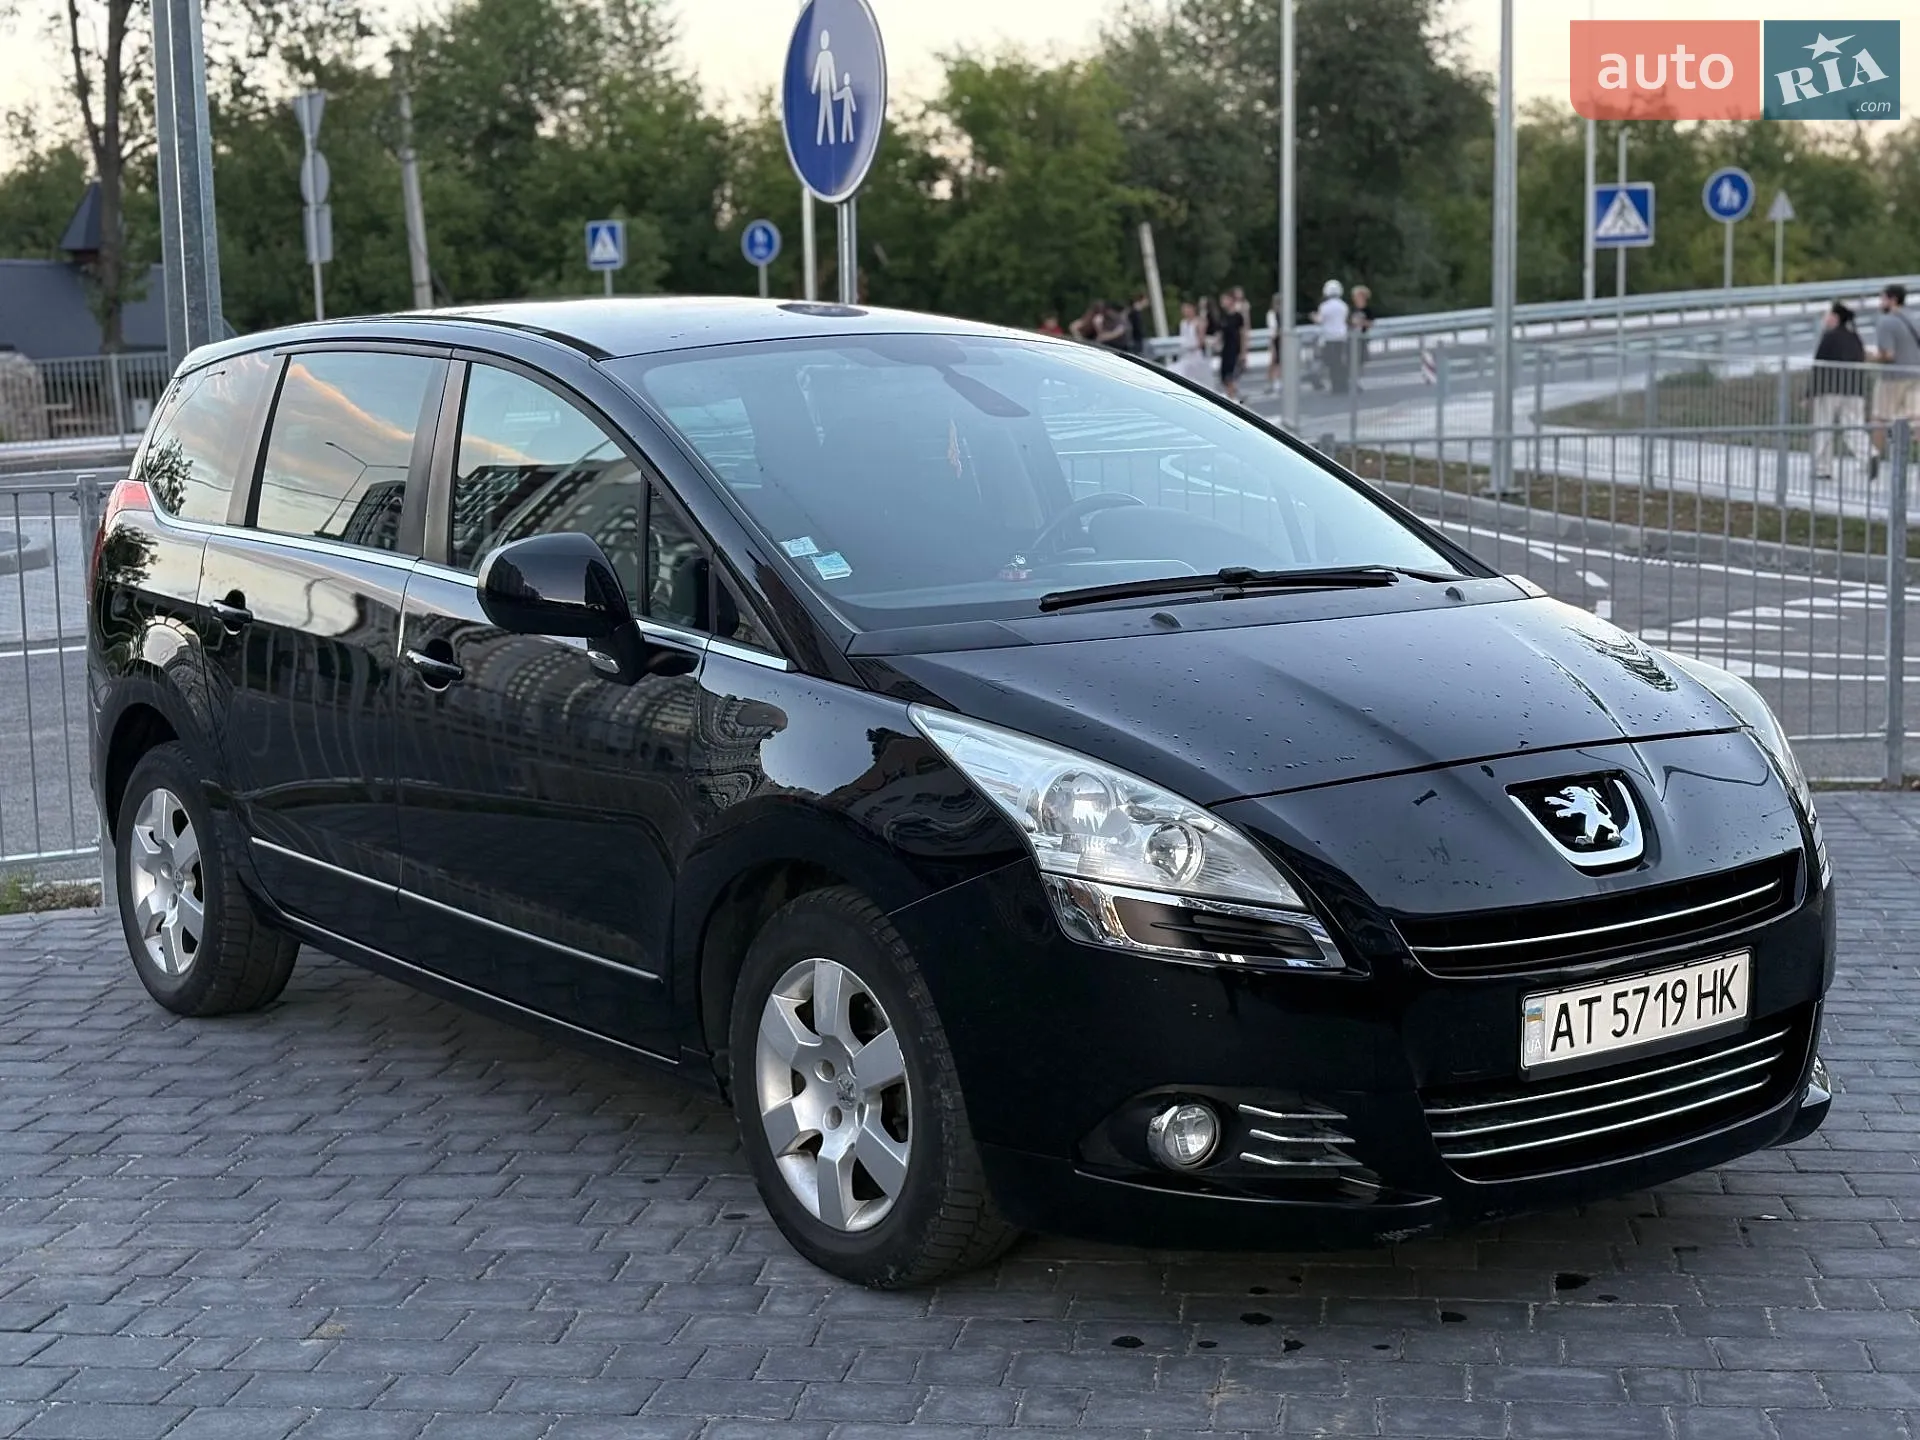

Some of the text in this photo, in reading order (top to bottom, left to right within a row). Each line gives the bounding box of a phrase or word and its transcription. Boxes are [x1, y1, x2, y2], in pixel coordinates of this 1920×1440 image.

[1550, 963, 1739, 1052] AT 5719 HK
[1526, 1038, 1542, 1055] UA
